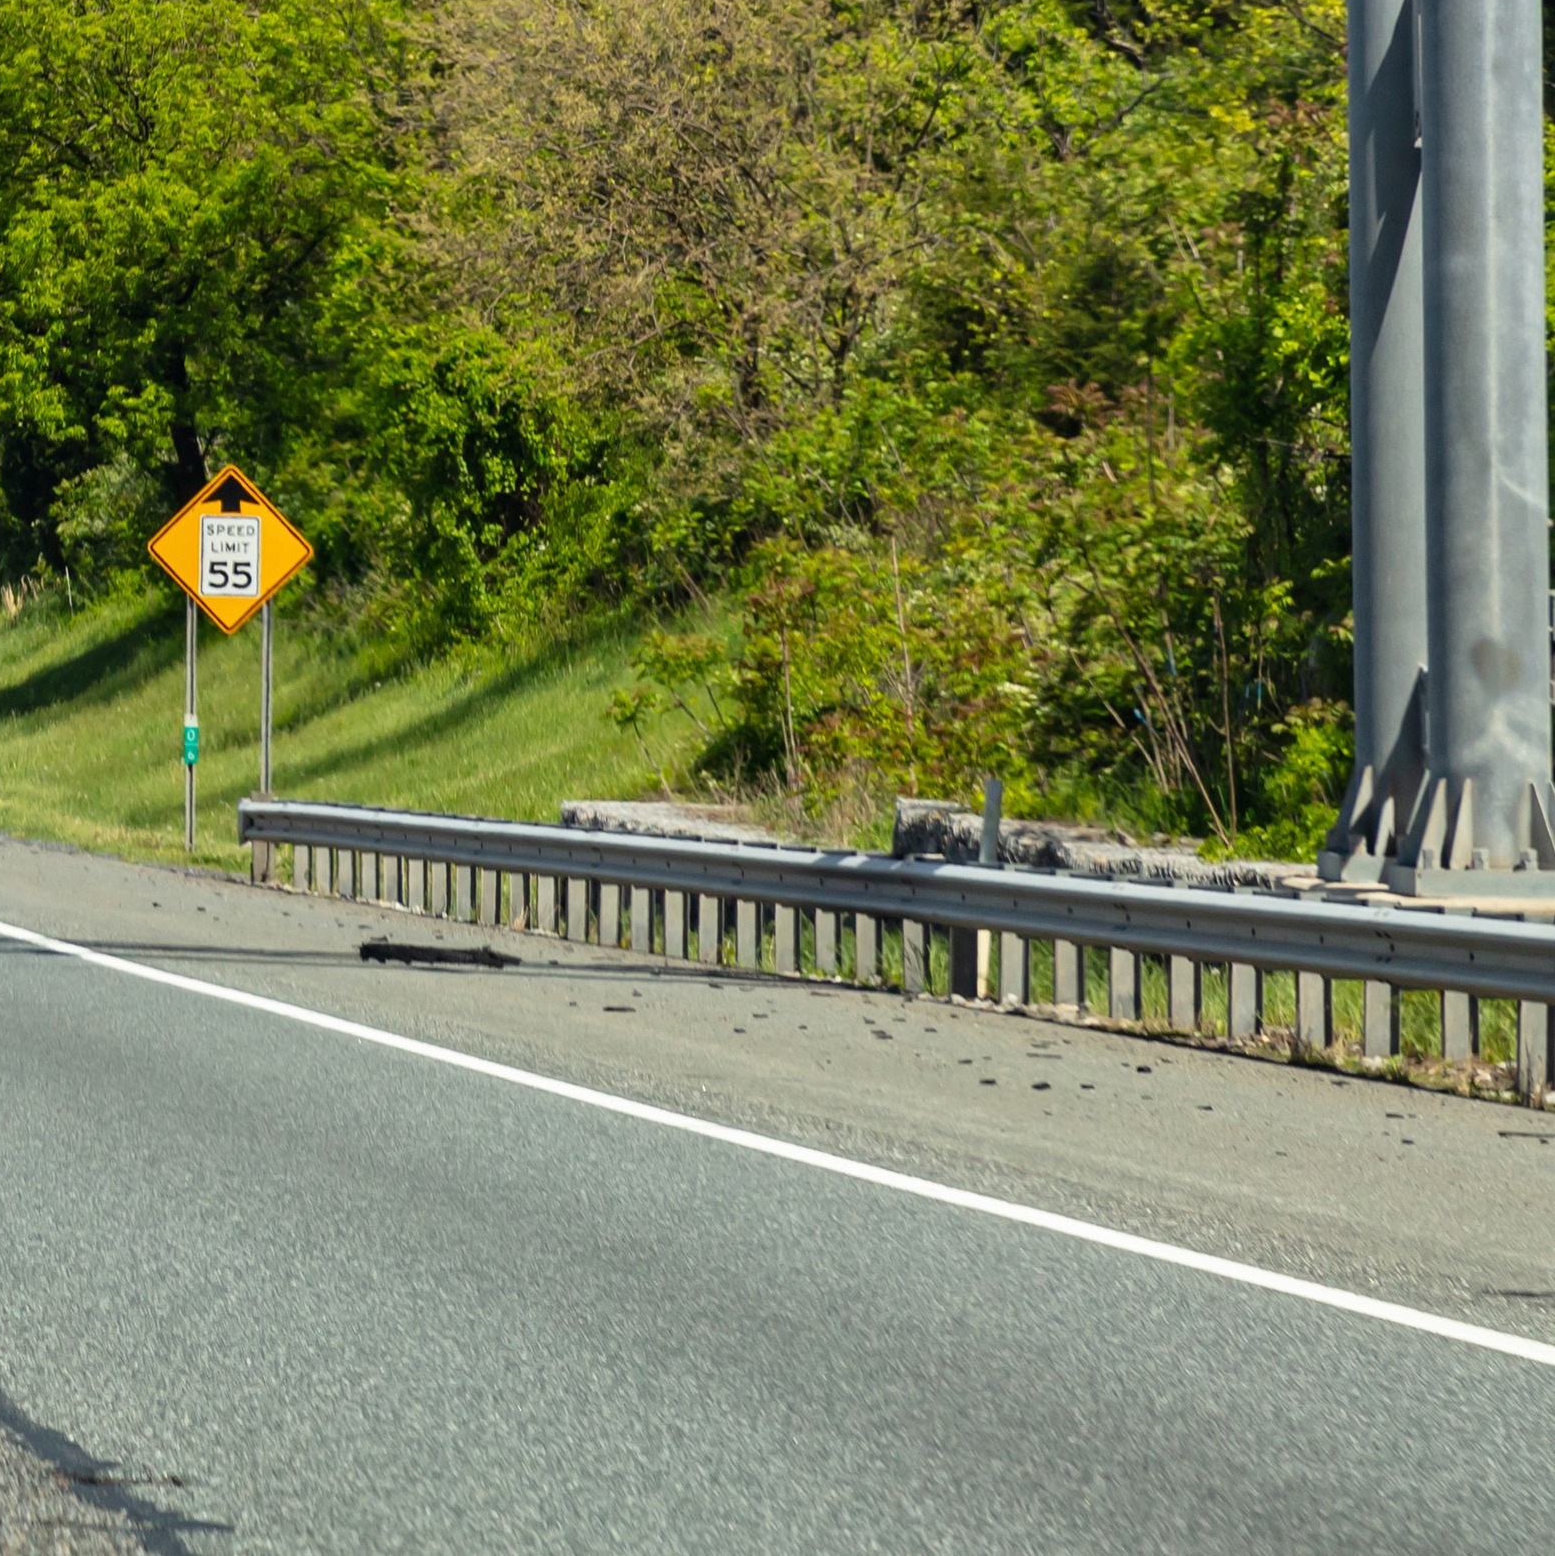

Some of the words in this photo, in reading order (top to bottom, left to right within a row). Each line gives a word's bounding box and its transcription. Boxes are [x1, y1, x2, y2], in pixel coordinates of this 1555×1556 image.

[207, 524, 255, 537] SPEED
[211, 541, 250, 553] LIMIT
[208, 561, 252, 589] 55
